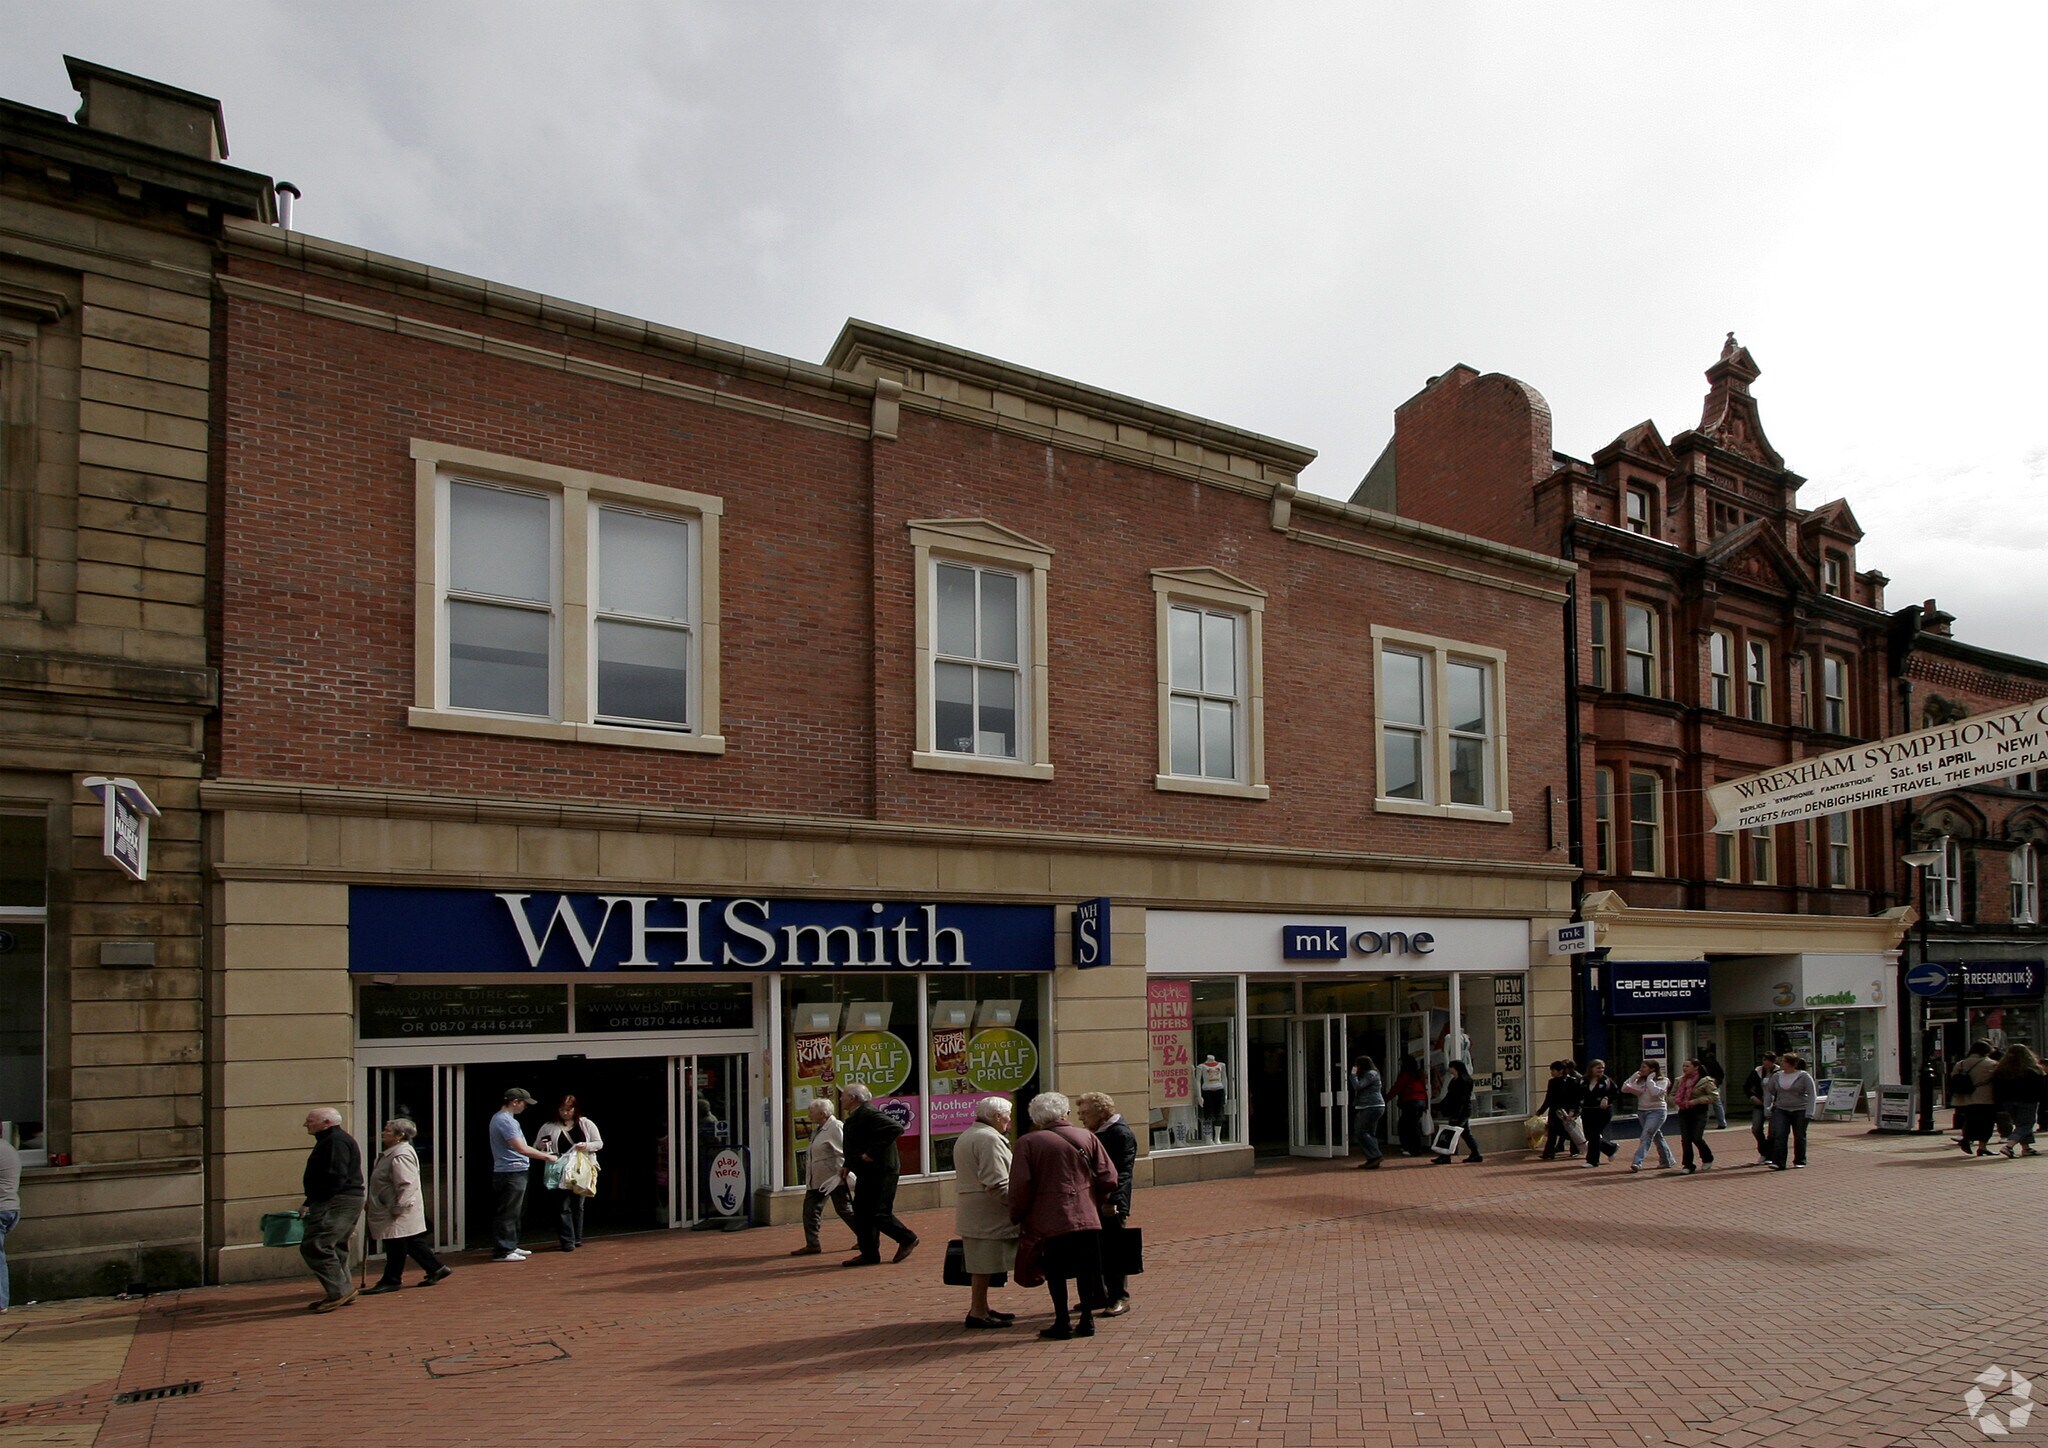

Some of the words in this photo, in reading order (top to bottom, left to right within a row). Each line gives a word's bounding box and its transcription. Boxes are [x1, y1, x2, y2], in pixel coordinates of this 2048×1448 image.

[1733, 753, 1857, 799] WREXHAM
[1864, 711, 2029, 769] SYMPHONY
[1890, 767, 1914, 779] Sat.
[1938, 751, 1976, 768] APRIL
[1996, 733, 2038, 754] NEWI
[1738, 811, 1779, 826] TICKETS
[1780, 807, 1802, 819] from
[1804, 786, 1889, 813] DENBIGHSHIRE
[1892, 776, 1941, 794] TRAVEL,
[1945, 768, 1972, 782] THE
[1974, 757, 2017, 776] MUSIC
[115, 816, 139, 851] HALIFAX
[1080, 903, 1098, 919] WH
[495, 893, 972, 968] WHSmith
[1561, 929, 1581, 938] mk
[1080, 918, 1099, 964] S
[1296, 929, 1340, 951] mk
[1354, 931, 1436, 954] one
[1559, 941, 1585, 951] one
[1971, 972, 2013, 985] RESEARCH
[2014, 972, 2026, 983] UK
[615, 988, 665, 998] ORDER
[667, 987, 714, 998] DIRECT
[1495, 979, 1521, 993] NEW
[409, 990, 464, 1000] ORDER
[1495, 993, 1522, 1004] OFFERS
[1632, 990, 1678, 998] CLOTHING
[1773, 982, 1796, 1006] 3
[1150, 1002, 1188, 1018] NEW
[1496, 1009, 1511, 1017] CITY
[401, 1022, 424, 1033] OR
[430, 1021, 466, 1032] 0870
[609, 1017, 629, 1027] OR
[634, 1016, 665, 1027] 0870
[1150, 1018, 1188, 1029] OFFERS
[1497, 1016, 1521, 1025] SHORTS
[934, 1031, 965, 1044] STEPHEN
[1504, 1024, 1522, 1041] £8
[796, 1035, 832, 1049] STEPHEN
[974, 1042, 991, 1050] BUY
[1000, 1040, 1017, 1048] GET
[1151, 1034, 1178, 1046] TOPS
[798, 1044, 832, 1062] KING
[841, 1044, 860, 1052] BUY
[870, 1042, 889, 1050] GET
[935, 1039, 966, 1057] KING
[1497, 1045, 1522, 1055] SHIRTS
[836, 1050, 903, 1072] HALF
[969, 1047, 1030, 1069] HALF
[1163, 1045, 1188, 1066] £4
[1504, 1054, 1521, 1071] £8
[844, 1069, 895, 1086] PRICE
[977, 1066, 1023, 1081] PRICE
[1152, 1069, 1189, 1078] TROUSERS
[1164, 1077, 1189, 1098] £8
[931, 1099, 981, 1111] Mother's
[931, 1112, 949, 1120] Only
[717, 1157, 738, 1168] play
[715, 1168, 740, 1178] here!
